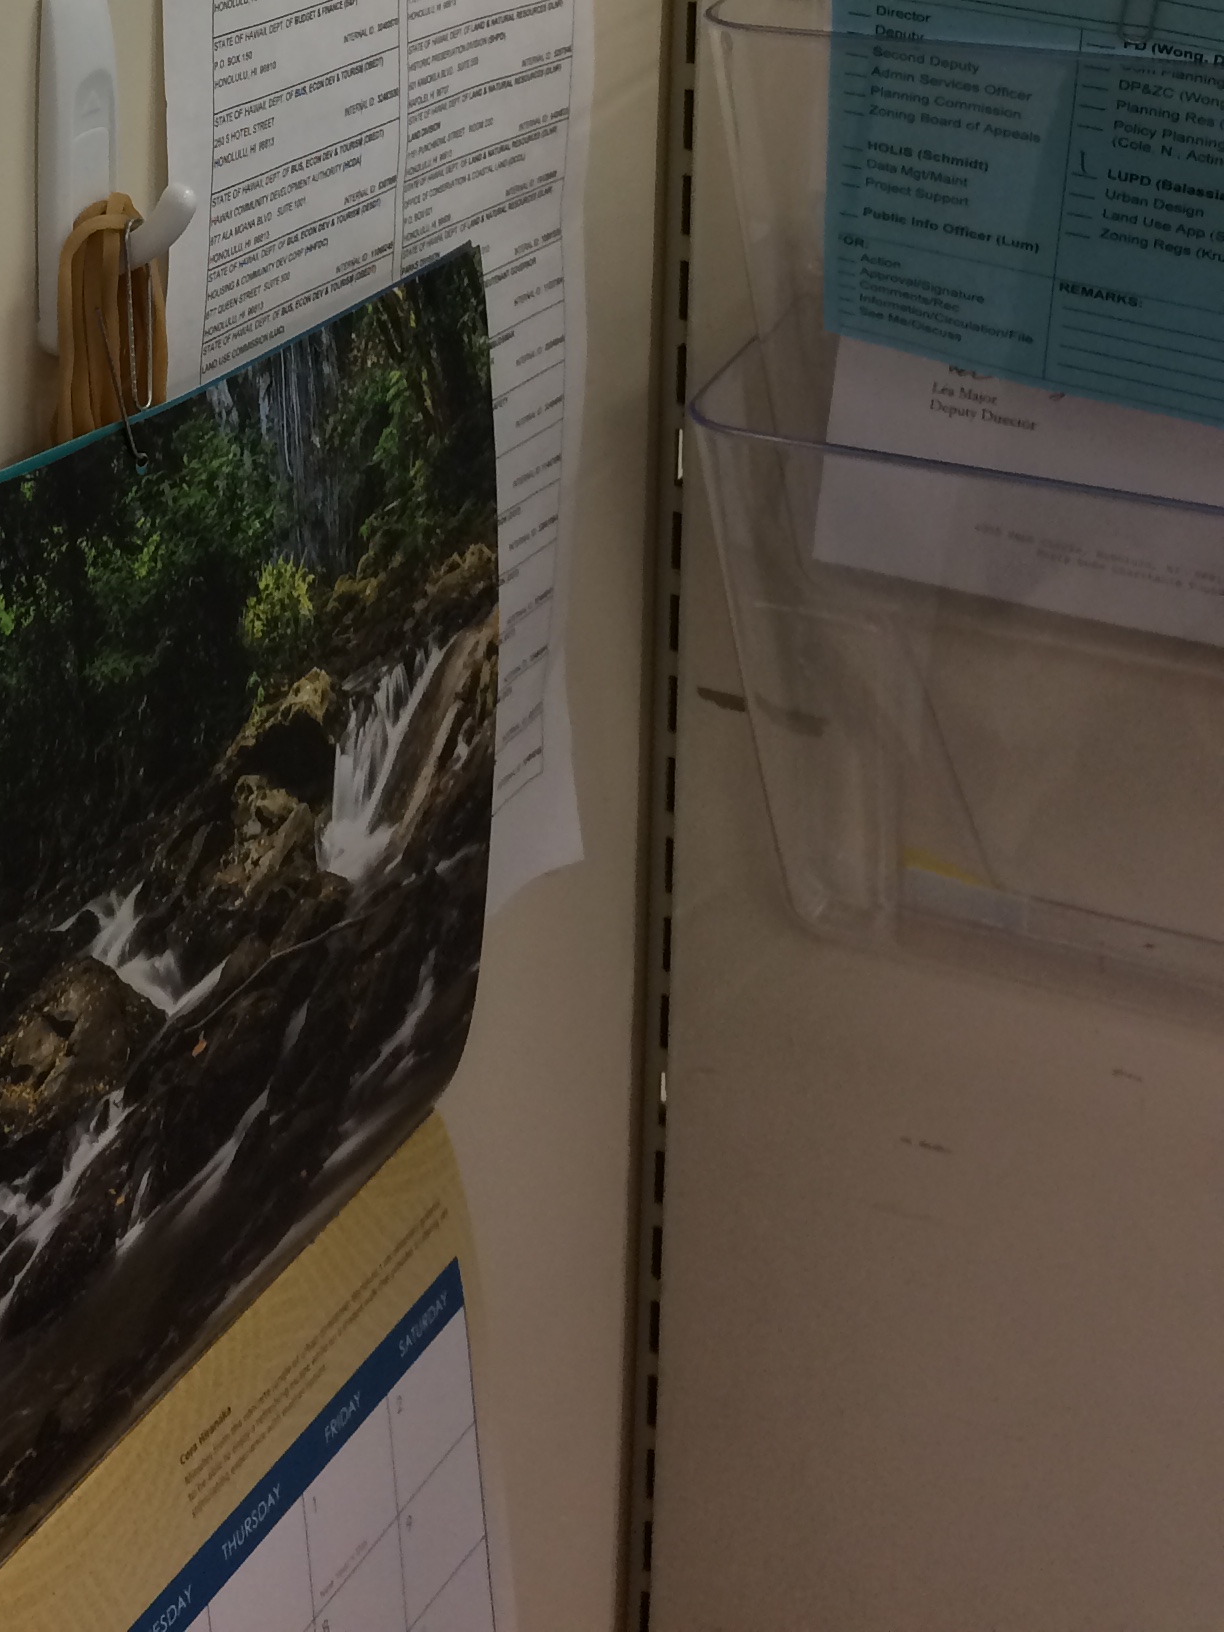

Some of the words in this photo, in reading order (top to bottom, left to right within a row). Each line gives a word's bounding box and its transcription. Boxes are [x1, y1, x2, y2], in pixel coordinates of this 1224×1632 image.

[876, 5, 931, 23] Director
[872, 45, 925, 65] Second
[929, 55, 980, 75] Deputy
[870, 65, 915, 82] Admin
[919, 73, 980, 93] Services
[984, 84, 1033, 101] Officer
[1118, 79, 1174, 99] DP&ZC
[870, 85, 930, 107] Planning
[934, 96, 1022, 119] Commission
[1116, 99, 1180, 123] Planning
[1185, 111, 1215, 128] Res
[869, 104, 916, 124] Zoning
[920, 112, 962, 129] Board
[965, 121, 981, 131] of
[983, 123, 1041, 143] Appeals
[1113, 120, 1157, 140] Policy
[866, 158, 898, 174] Data
[867, 140, 913, 158] HOLIS
[917, 149, 989, 172] (Schmidt)
[865, 176, 912, 196] Project
[915, 187, 969, 206] Support
[1107, 168, 1152, 187] LUPD
[1105, 188, 1149, 207] Urban
[1153, 198, 1204, 219] Design
[862, 206, 906, 225] Public
[911, 216, 939, 231] Info
[942, 223, 992, 242] Officer
[996, 234, 1040, 255] (Lum)
[1102, 208, 1138, 225] Land
[1142, 216, 1172, 232] Use
[1175, 224, 1206, 240] App
[1099, 227, 1149, 250] Zoning
[1153, 238, 1191, 257] Regs
[860, 253, 901, 268] Action
[859, 280, 959, 313] Comments/Rec
[860, 267, 985, 304] Approval/Signature
[1059, 280, 1142, 308] REMARKS:
[152, 1584, 191, 1632] ESDAY
[221, 1484, 280, 1560] THURSDAY
[324, 1391, 360, 1443] FRIDAY
[398, 1291, 447, 1357] SATURDAY
